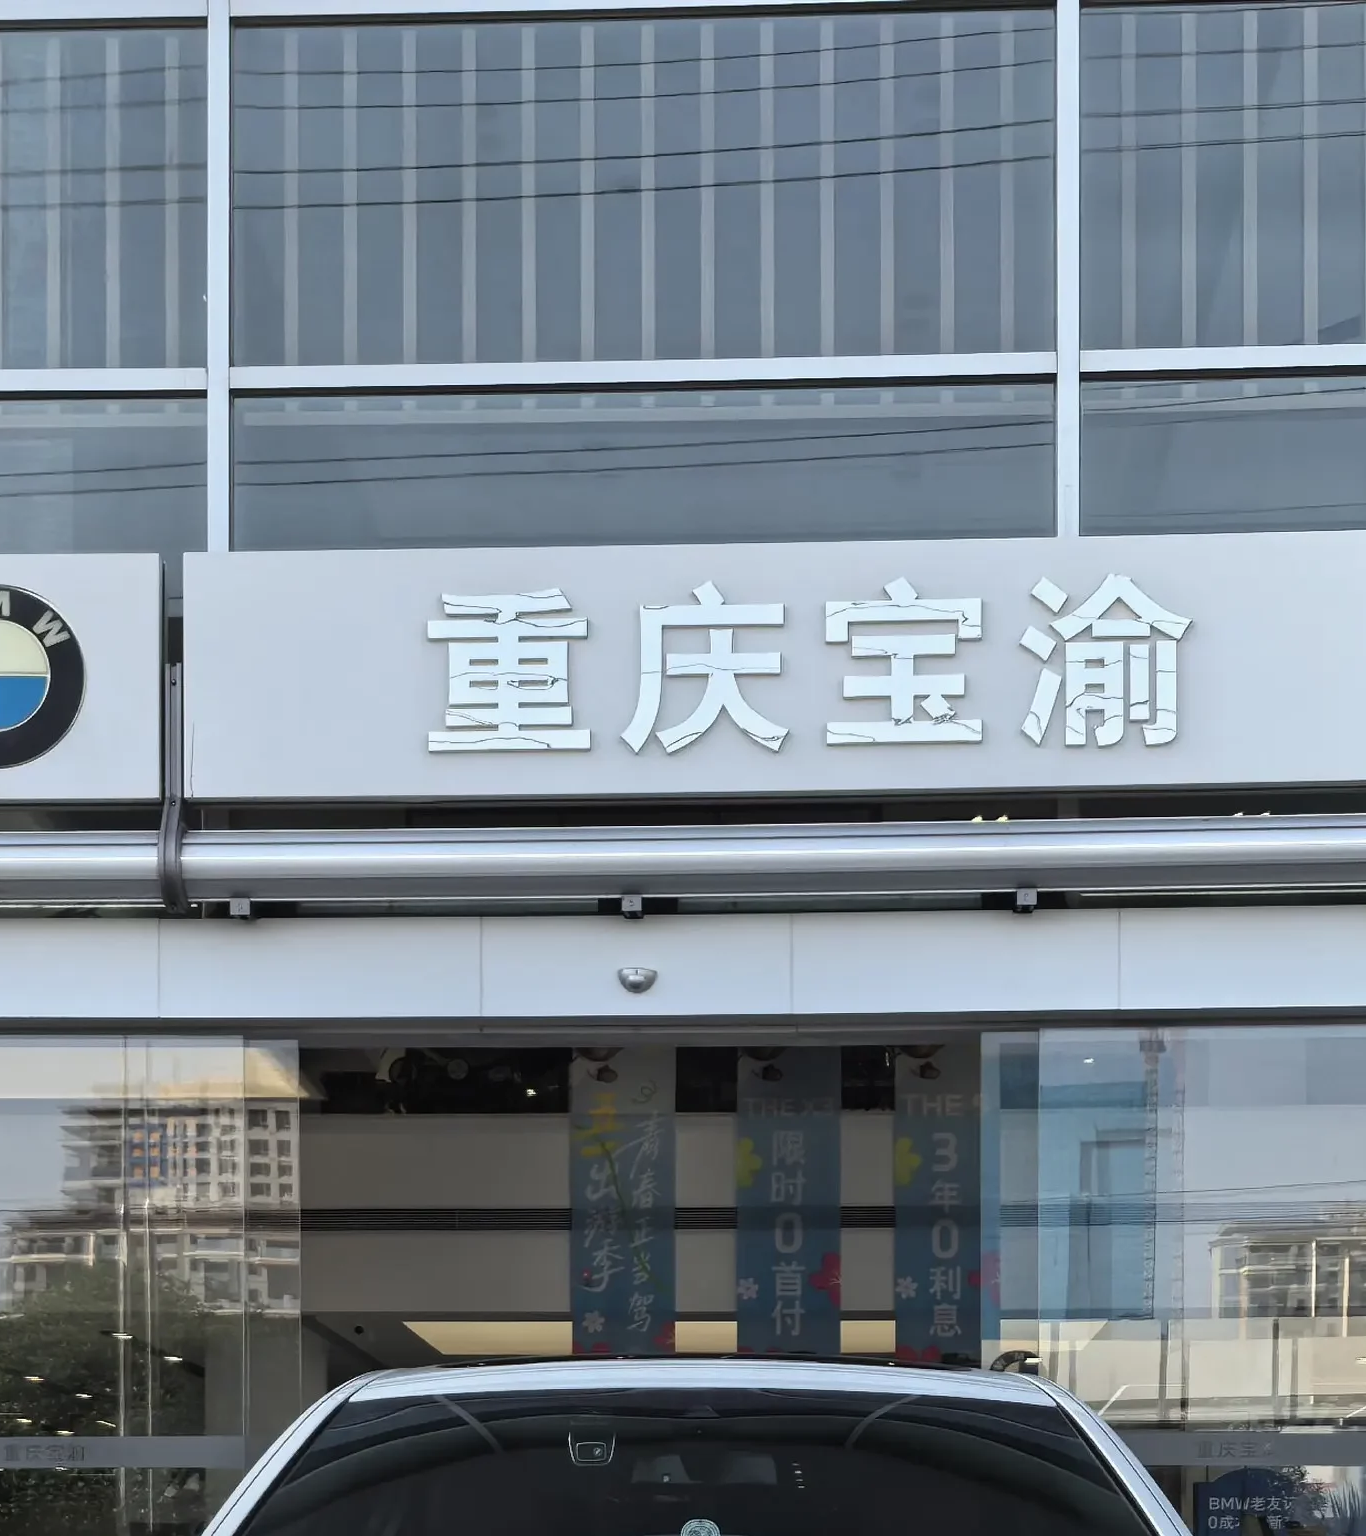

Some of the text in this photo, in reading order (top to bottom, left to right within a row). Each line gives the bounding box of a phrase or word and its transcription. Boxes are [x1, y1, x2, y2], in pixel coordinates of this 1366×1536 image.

[426, 573, 1194, 756] 重庆宝渝
[900, 1093, 965, 1118] THE
